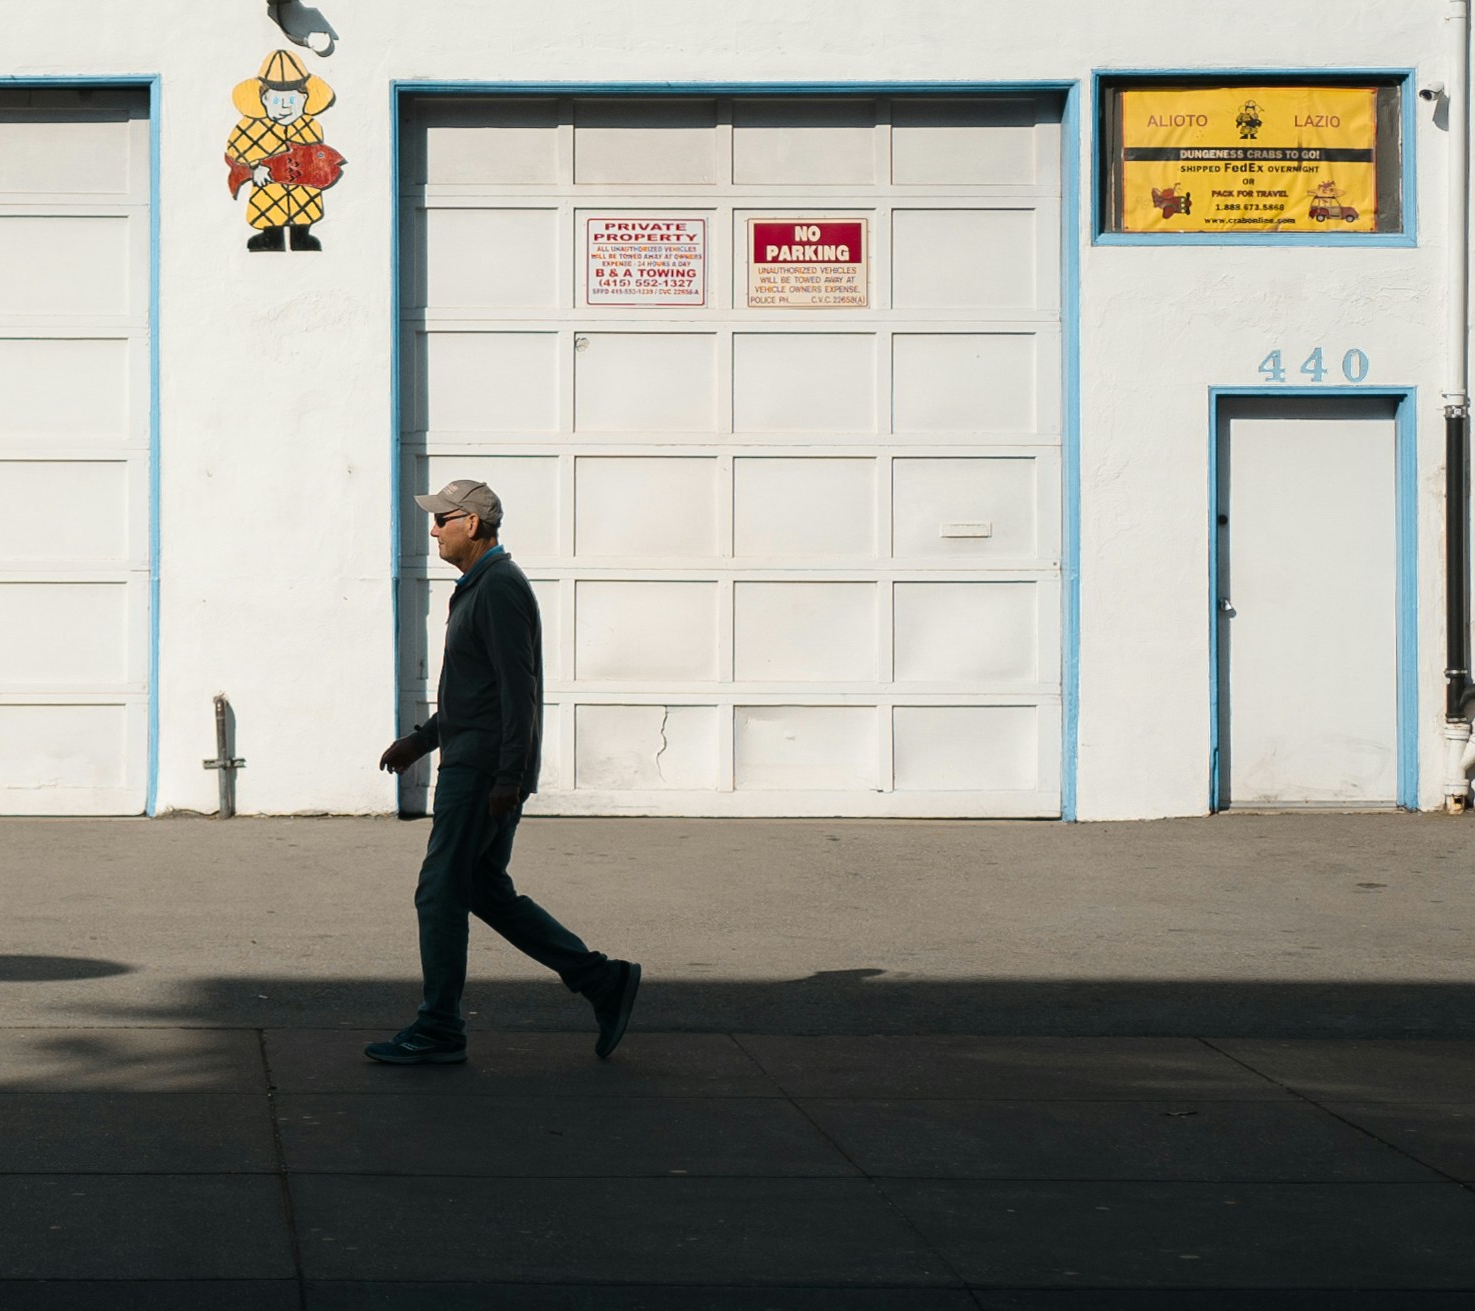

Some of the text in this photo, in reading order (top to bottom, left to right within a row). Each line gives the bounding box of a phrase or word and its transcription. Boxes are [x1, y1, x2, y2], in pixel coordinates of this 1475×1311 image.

[1147, 114, 1341, 128] ALIOTO LAZIO
[1179, 150, 1244, 159] DUNGENESS
[1247, 150, 1283, 159] CRABS
[1285, 150, 1299, 159] TO
[1224, 162, 1264, 172] FedEx
[1267, 165, 1319, 173] OVERNIGHT
[1242, 178, 1255, 186] OR
[1211, 190, 1289, 198] PACK FOR TRAVEL
[604, 223, 687, 231] PRIVATE
[593, 233, 697, 242] PROPERTY
[794, 225, 821, 242] NO
[766, 244, 850, 261] PARKING
[595, 268, 697, 278] B & A TOWING
[757, 266, 857, 275] UNAUTHORIZED VEHICLES
[599, 279, 693, 288] (415) 552-1327
[759, 276, 856, 284] WILL BE TOWED AWAY AT
[750, 296, 776, 304] POLICE
[1258, 347, 1369, 383] 440
